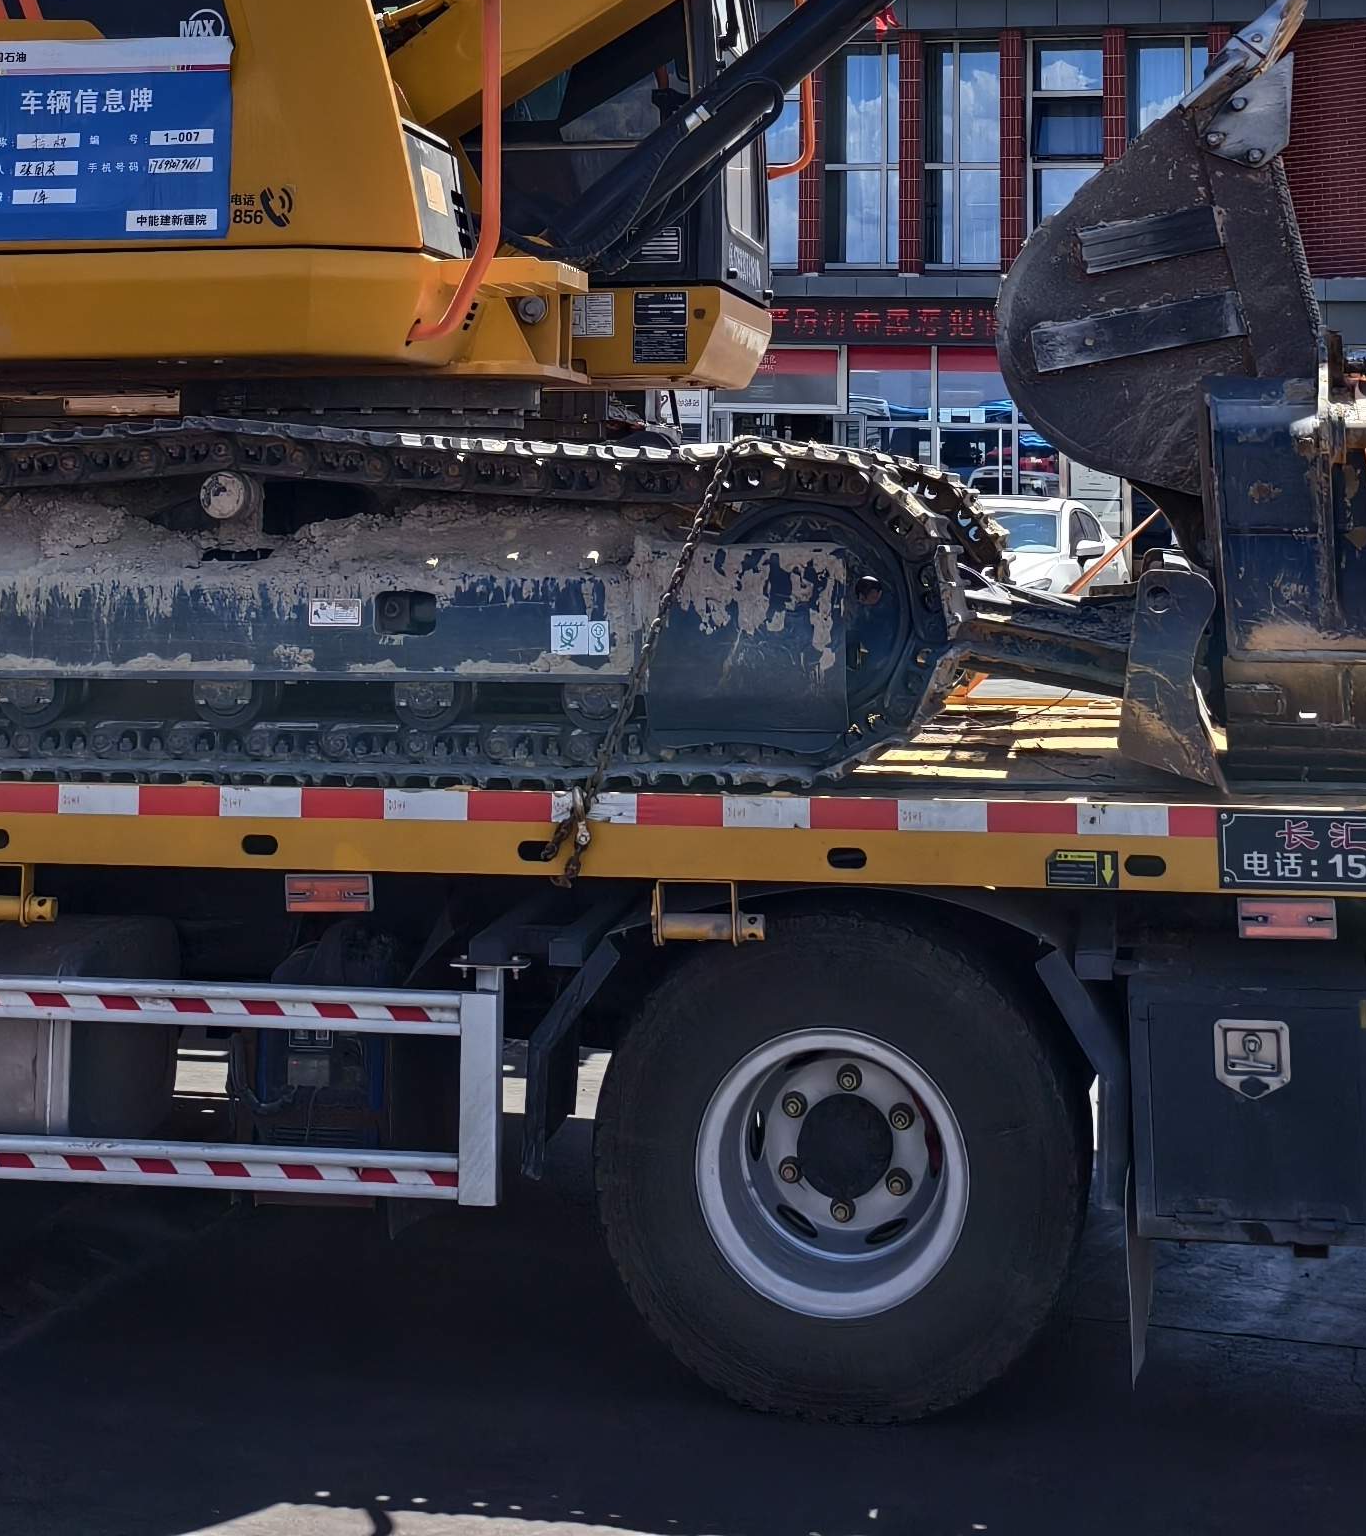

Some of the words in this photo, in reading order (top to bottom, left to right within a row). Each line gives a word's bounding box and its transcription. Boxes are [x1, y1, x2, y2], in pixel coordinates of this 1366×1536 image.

[179, 19, 215, 37] MAX
[20, 87, 154, 115] 车辆信息牌
[164, 131, 200, 143] 1-007
[137, 214, 207, 227] 中能建新疆院
